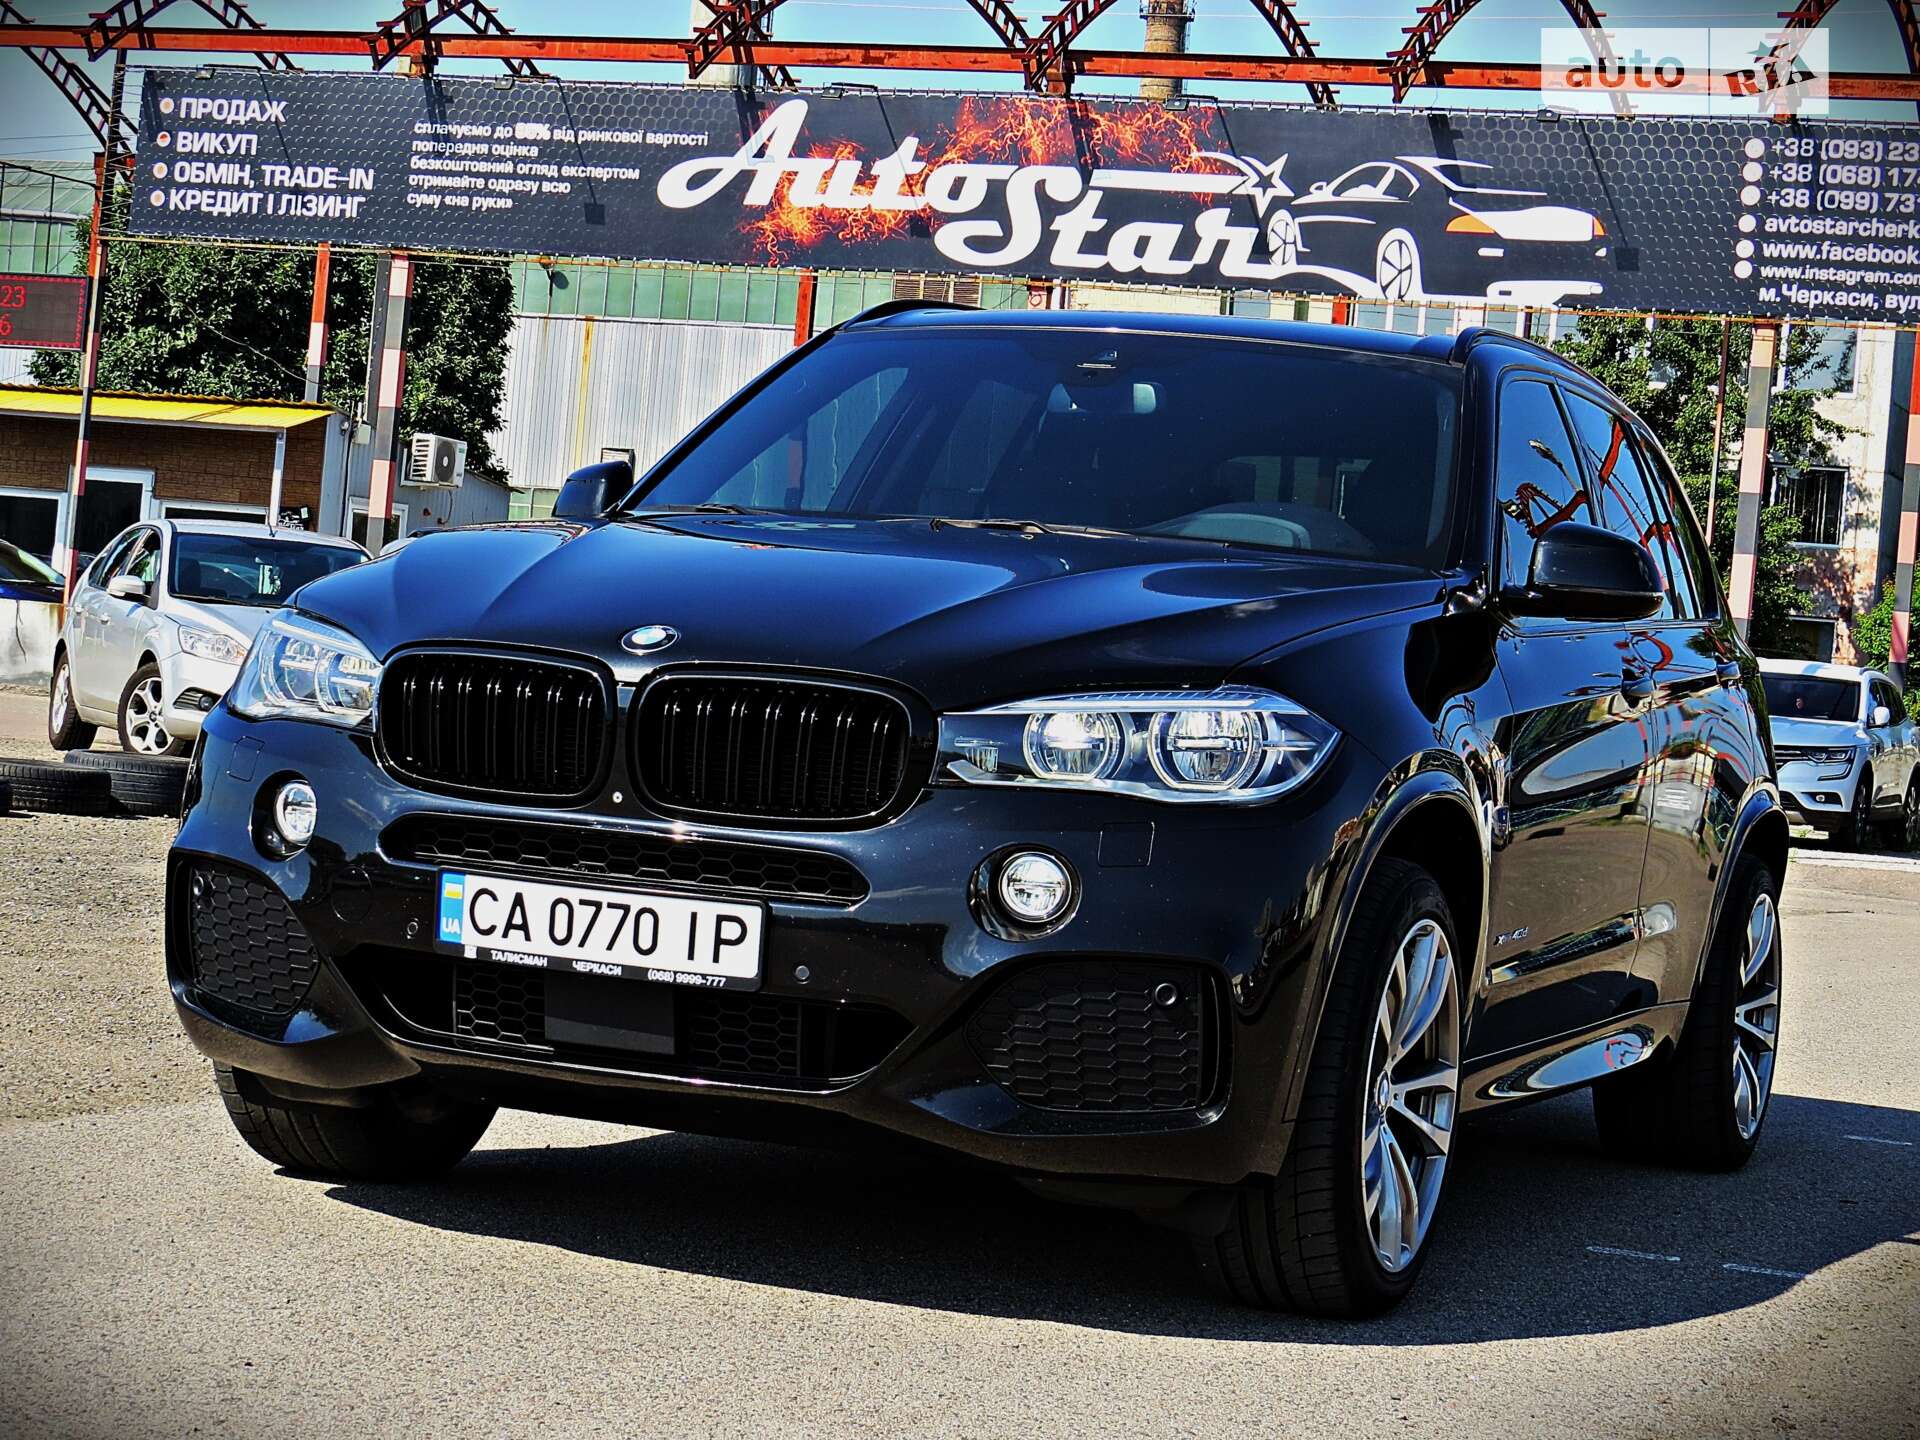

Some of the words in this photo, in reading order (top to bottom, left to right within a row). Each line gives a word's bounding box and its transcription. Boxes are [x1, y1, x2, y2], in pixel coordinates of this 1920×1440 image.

[180, 97, 287, 125] ПРОДАЖ
[176, 131, 258, 156] ВИКУП
[414, 122, 492, 139] сплачуємо
[493, 126, 513, 139] до
[553, 126, 575, 143] від
[578, 129, 643, 145] ринкової
[645, 131, 709, 148] вартості
[411, 140, 489, 157] попередня
[491, 141, 539, 157] оцінка
[657, 99, 1018, 215] Auto
[1772, 137, 1814, 157] +38
[1820, 139, 1883, 163] (093)
[173, 162, 254, 189] ОБМІН,
[260, 165, 375, 191] TRADE-IN
[410, 155, 514, 173] безкоштовний
[516, 163, 558, 178] огляд
[561, 166, 640, 182] експертом
[1769, 163, 1812, 182] +38
[1818, 164, 1882, 189] (068)
[1887, 167, 1920, 188] 17
[408, 174, 485, 191] отримайте
[488, 179, 539, 195] одразу
[541, 181, 571, 194] всю
[169, 189, 263, 217] КРЕДИТ
[279, 195, 366, 219] ЛІЗИНГ
[406, 192, 441, 208] суму
[1767, 188, 1810, 209] +38
[1817, 189, 1879, 214] (099)
[1884, 191, 1920, 213] 73
[934, 165, 1272, 279] Star
[442, 916, 462, 935] UA
[469, 887, 531, 943] CA
[549, 897, 659, 956] 0770
[687, 911, 748, 964] IP
[490, 949, 547, 967] ТАЛИСМАН
[572, 960, 622, 976] ЧЕРКАСИ
[648, 967, 675, 983] (068)
[676, 971, 727, 988] 9999-777
